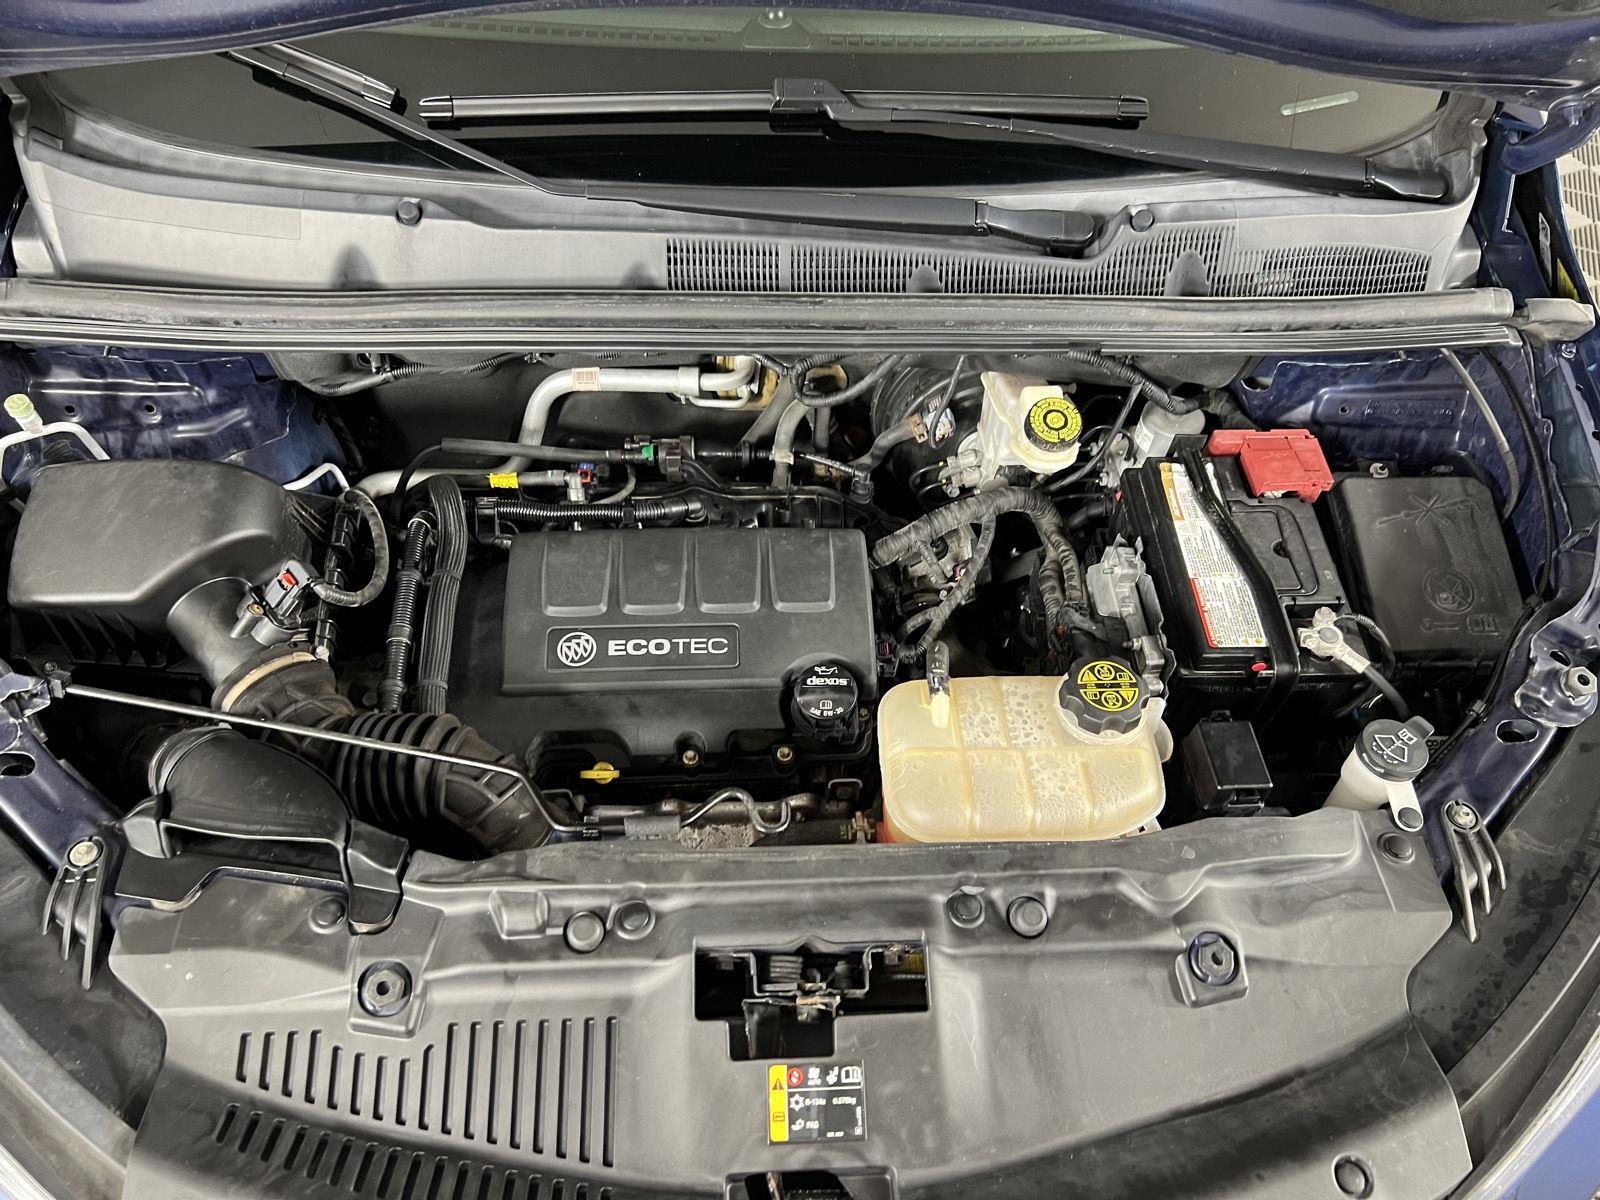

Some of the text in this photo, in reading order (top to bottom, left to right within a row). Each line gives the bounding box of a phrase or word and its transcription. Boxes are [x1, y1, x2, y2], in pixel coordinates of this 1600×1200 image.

[607, 637, 729, 656] ECOTEC
[806, 675, 848, 686] dexos
[809, 706, 822, 716] SAE
